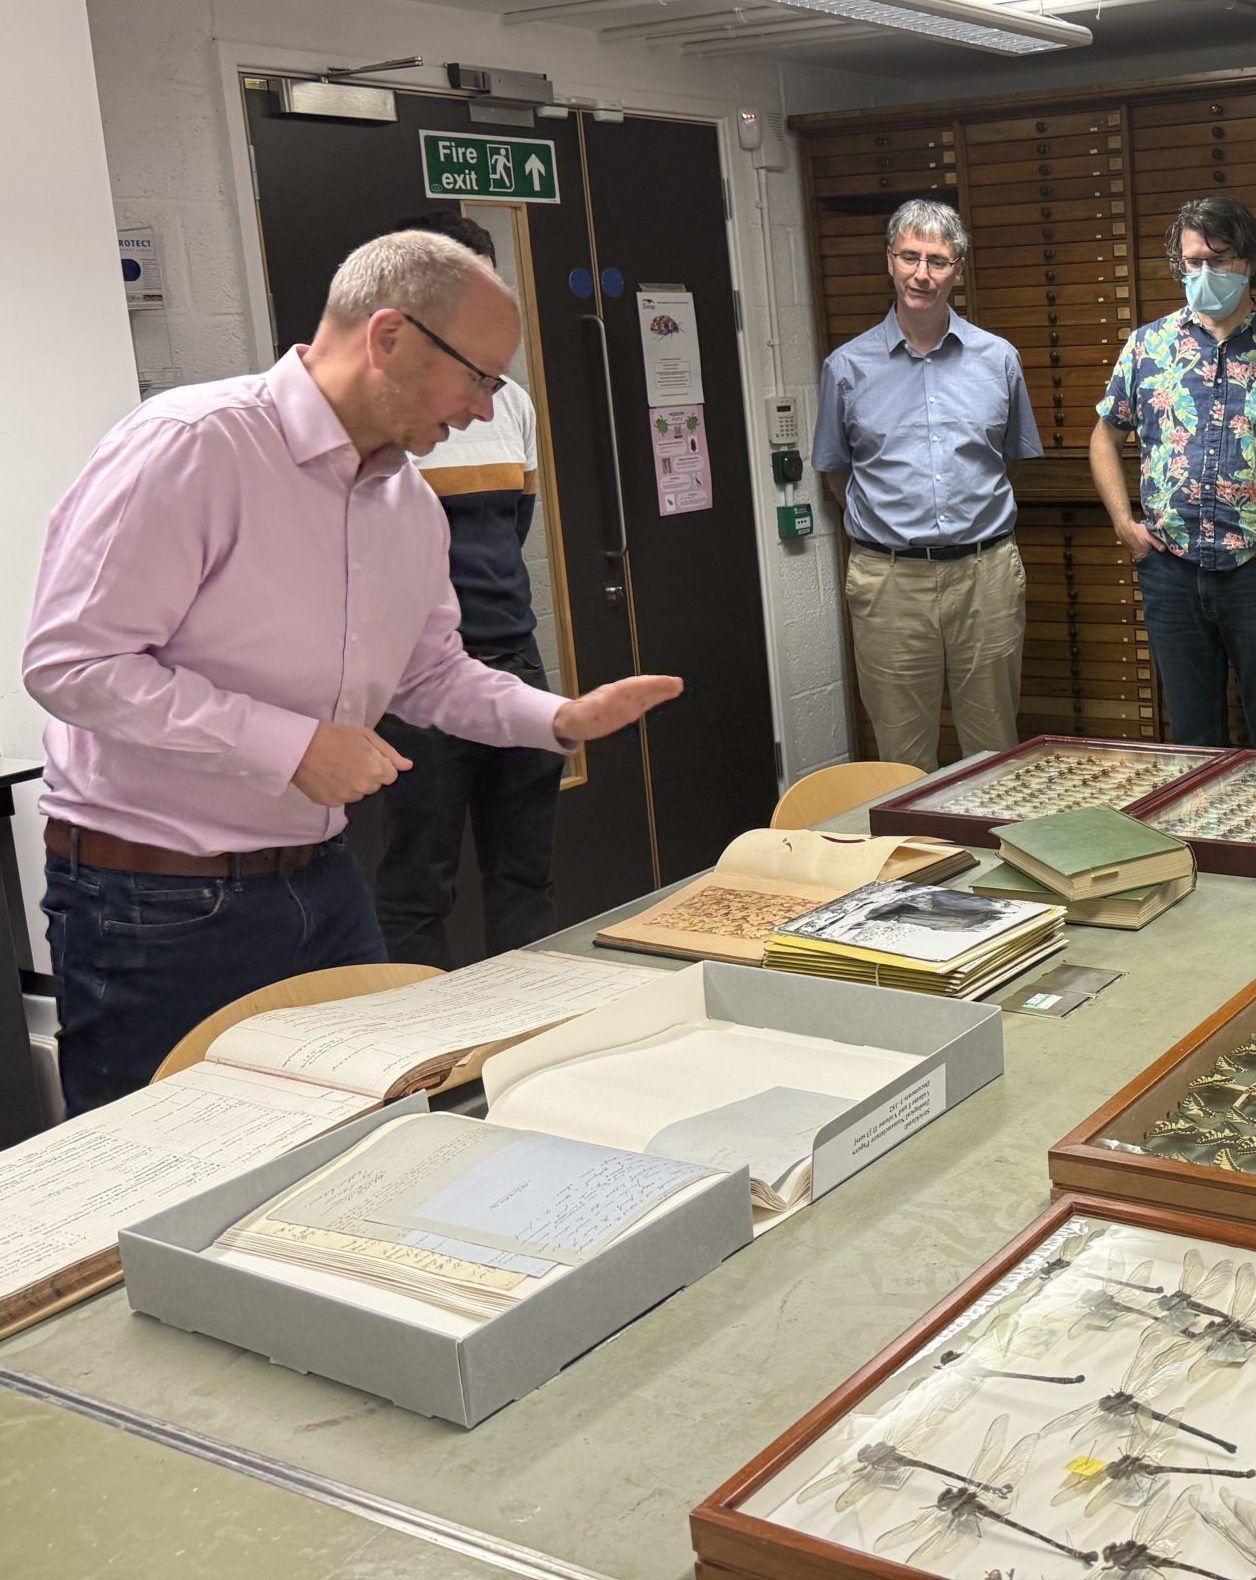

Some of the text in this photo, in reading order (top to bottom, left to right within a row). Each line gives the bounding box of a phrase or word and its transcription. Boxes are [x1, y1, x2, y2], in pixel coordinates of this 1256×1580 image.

[438, 141, 478, 164] Fire
[441, 169, 479, 190] exit
[118, 239, 152, 248] ROTECT
[904, 1081, 930, 1101] Documents
[912, 1091, 929, 1105] Volume
[898, 1104, 907, 1116] and
[852, 1098, 930, 1155] Zoological Nomenclature Papers
[879, 1113, 897, 1128] Volume
